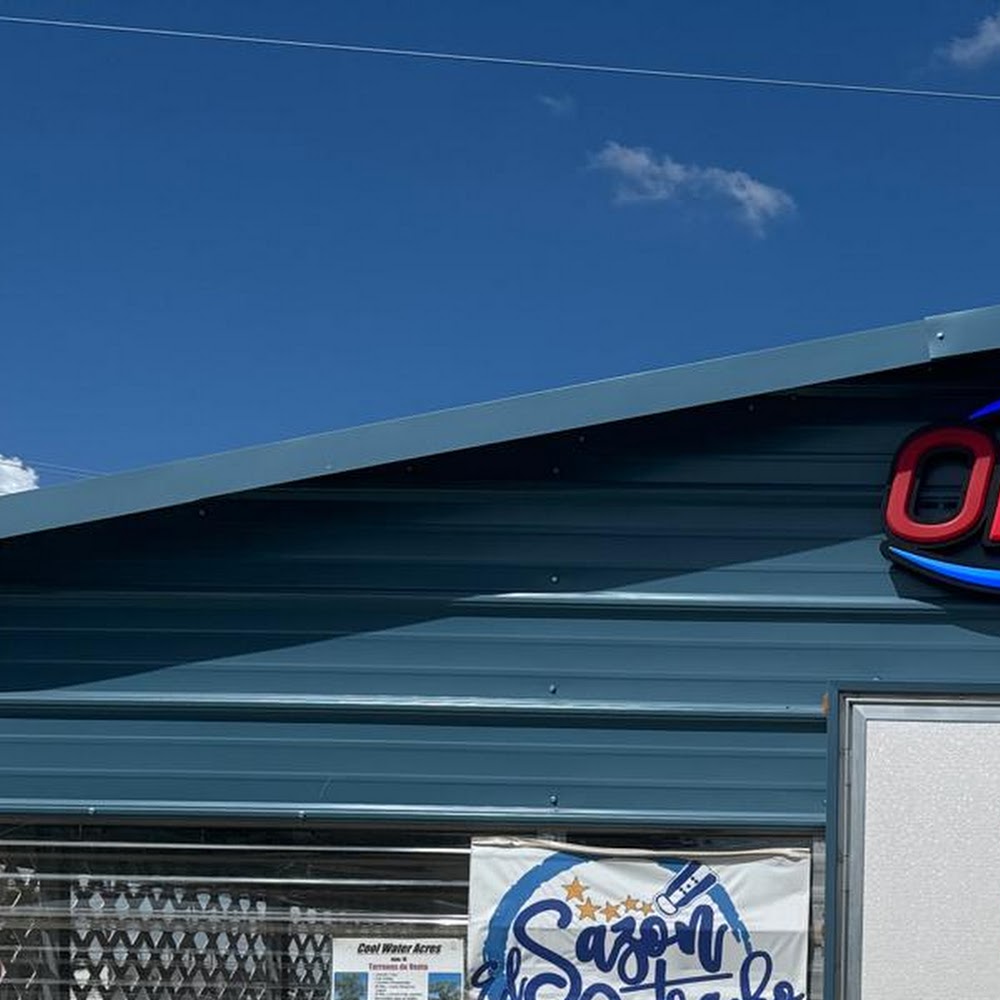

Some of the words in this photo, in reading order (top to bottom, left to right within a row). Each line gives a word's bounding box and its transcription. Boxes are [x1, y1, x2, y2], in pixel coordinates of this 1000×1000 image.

[357, 943, 381, 954] Cool
[381, 943, 412, 954] Water
[412, 944, 442, 954] Acres
